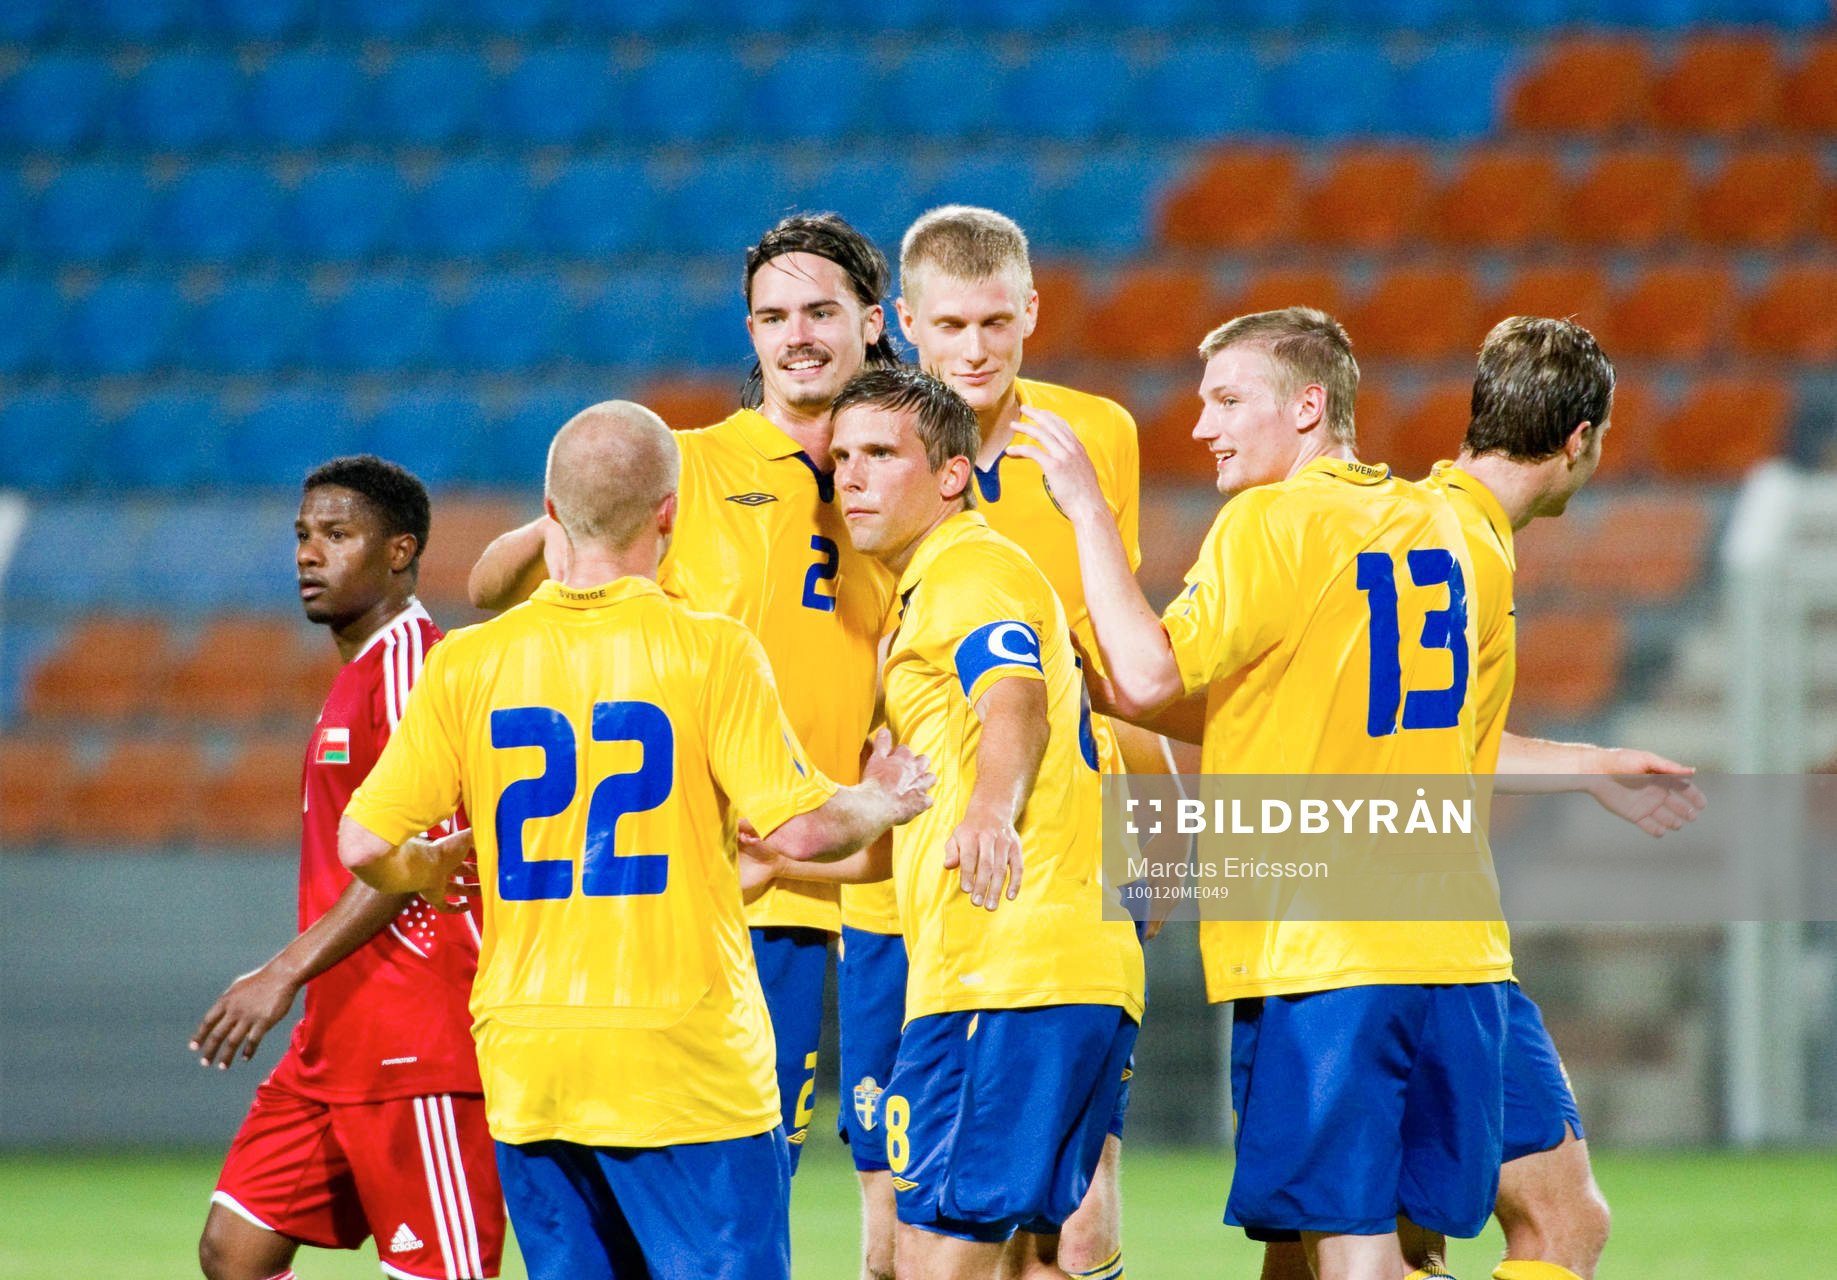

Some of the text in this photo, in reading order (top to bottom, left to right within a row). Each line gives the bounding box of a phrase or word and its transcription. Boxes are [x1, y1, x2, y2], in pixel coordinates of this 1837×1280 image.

[559, 588, 606, 600] SVERIGE
[802, 534, 839, 612] 2
[988, 623, 1038, 663] C
[1356, 548, 1469, 738] 13
[490, 701, 674, 901] 22
[885, 1094, 910, 1173] 8
